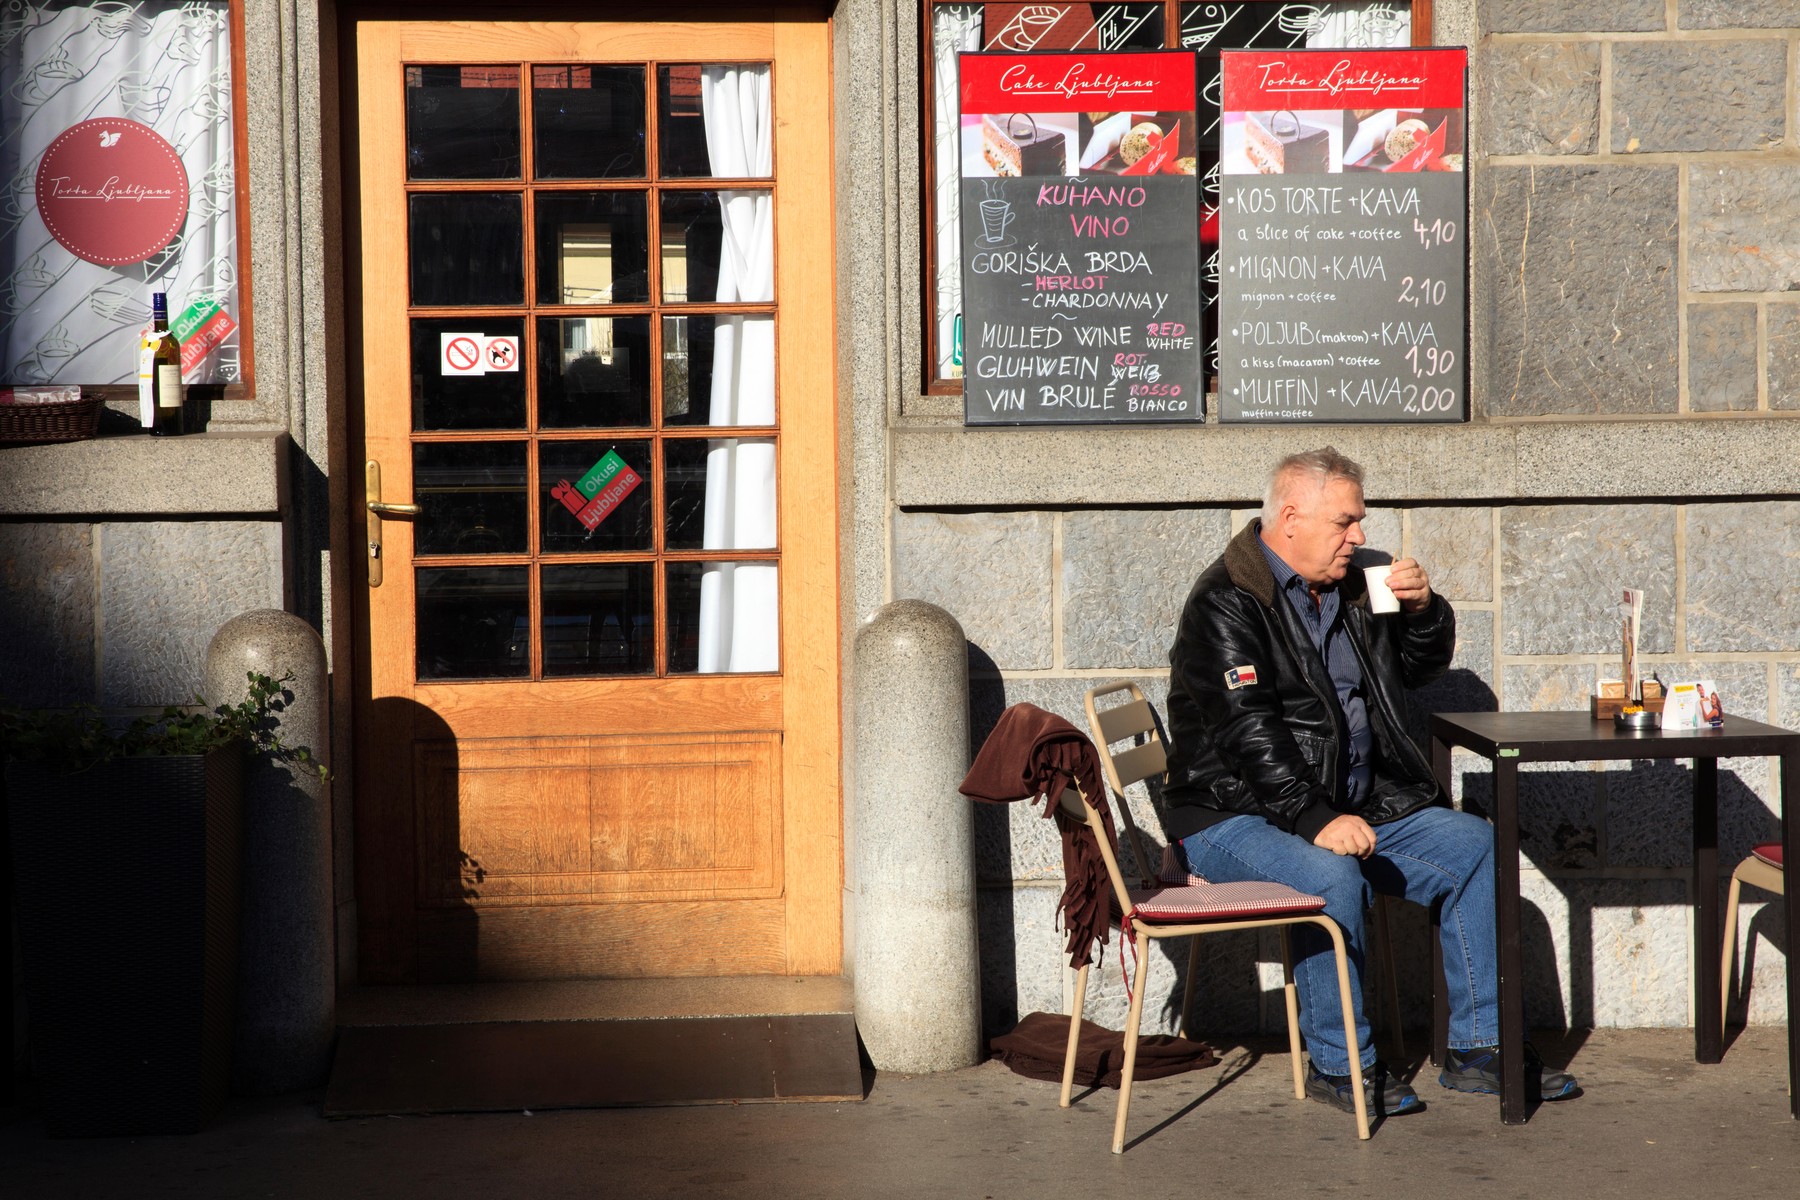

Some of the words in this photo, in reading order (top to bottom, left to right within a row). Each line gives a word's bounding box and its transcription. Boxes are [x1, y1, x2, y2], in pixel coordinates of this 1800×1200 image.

[999, 64, 1050, 92] Cake
[1054, 63, 1160, 99] Ljubljana
[1258, 61, 1313, 89] Torta
[1319, 60, 1428, 96] Ljubljana
[50, 176, 94, 199] Torta
[95, 174, 177, 202] Ljubljana
[1037, 184, 1147, 208] KUHANO
[1237, 188, 1276, 215] KOS
[1282, 187, 1343, 216] TORTE
[1069, 213, 1130, 239] VINO
[1238, 228, 1248, 242] a
[1294, 225, 1309, 242] of
[1316, 228, 1345, 240] cake
[1413, 218, 1456, 250] 4,10
[971, 242, 1072, 275] GORIŠKA
[1084, 251, 1153, 275] BRDA
[1239, 255, 1317, 283] MIGNON
[1241, 292, 1285, 310] mignon
[1296, 291, 1337, 303] coffee
[1397, 276, 1447, 308] 2,10
[980, 322, 1063, 349] MULLED
[1073, 325, 1132, 348] WINE
[1146, 322, 1186, 337] RED
[1146, 336, 1194, 351] WHITE
[976, 355, 1099, 381] GLUHWEIN
[1240, 358, 1250, 368] a
[1252, 355, 1275, 369] kiss
[1277, 353, 1335, 368] (macaron)
[1404, 345, 1455, 378] 1,90
[985, 388, 1026, 412] VIN
[1128, 384, 1183, 397] ROSSO
[1402, 384, 1455, 416] 2,00
[1126, 398, 1188, 412] BIANCO
[585, 458, 619, 493] Okusi
[582, 473, 636, 525] Ljubljane
